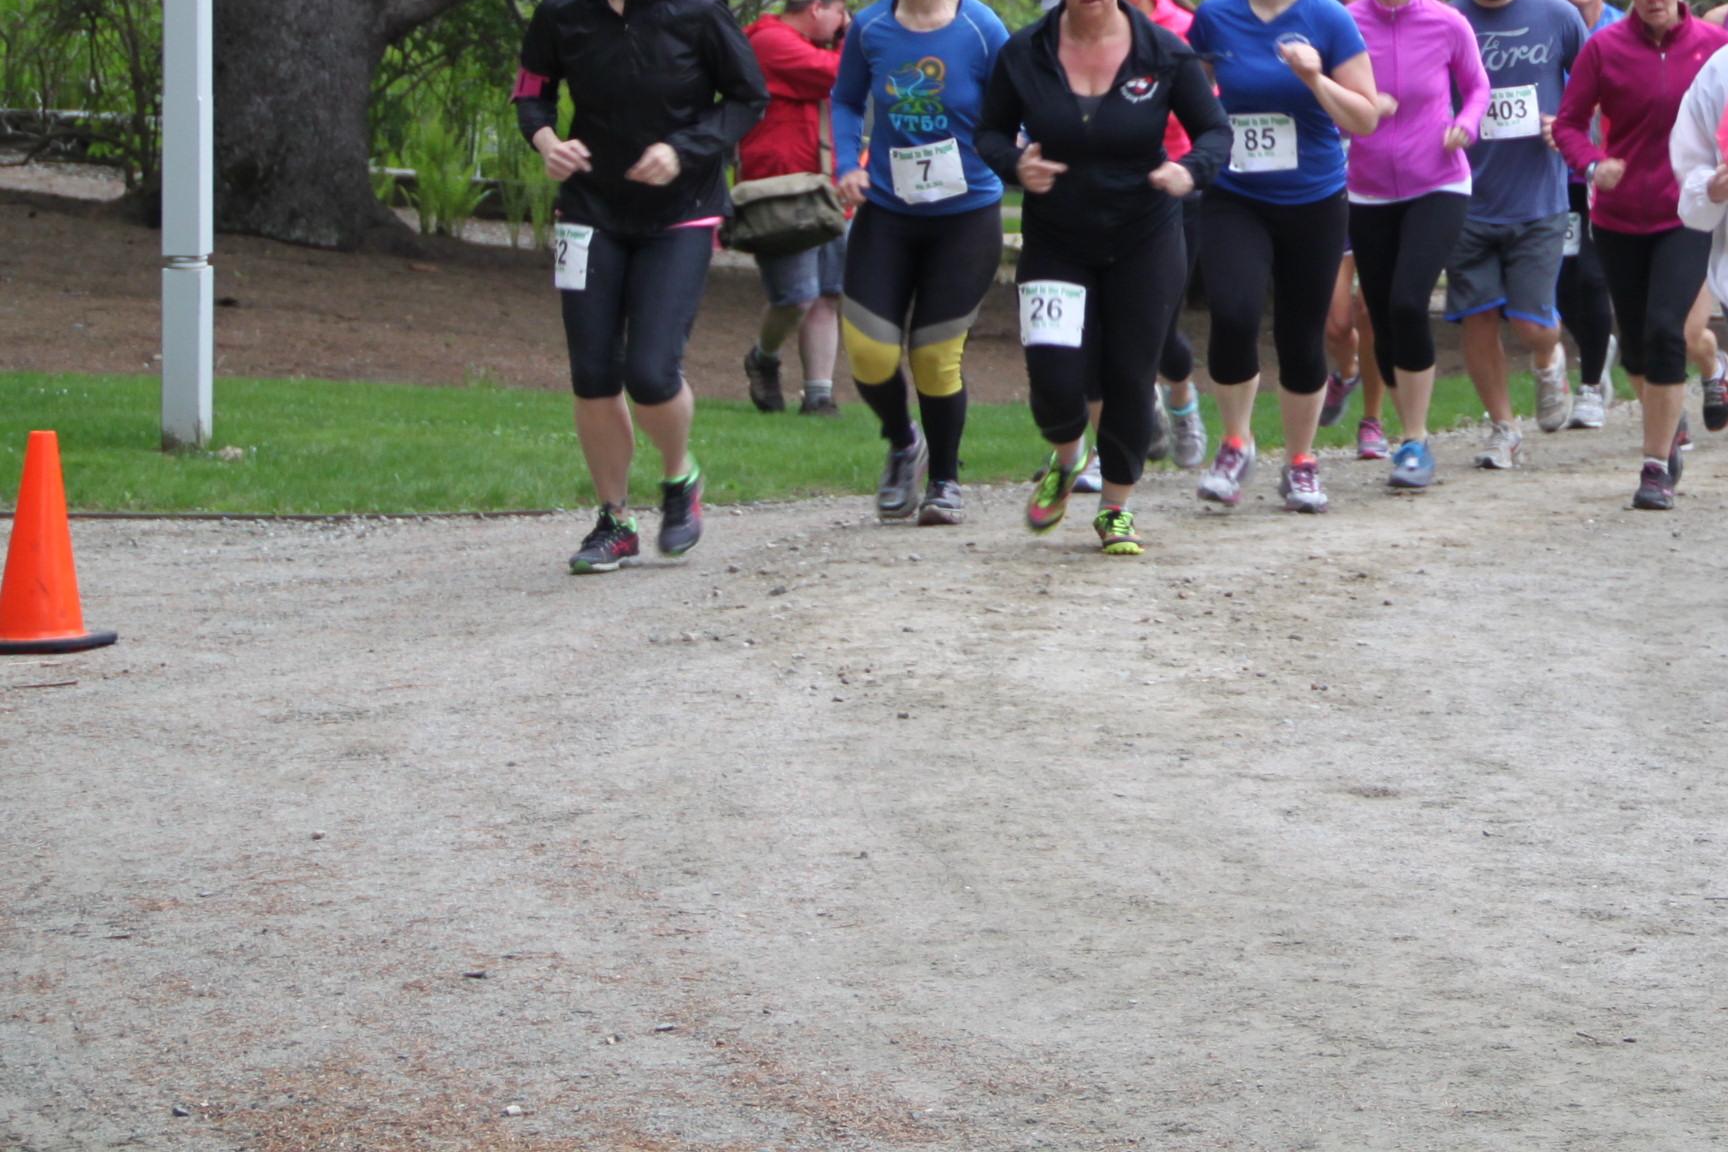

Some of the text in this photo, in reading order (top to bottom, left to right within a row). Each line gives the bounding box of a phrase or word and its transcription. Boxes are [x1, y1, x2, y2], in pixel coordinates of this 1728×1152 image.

[1476, 27, 1553, 70] Ford
[888, 112, 948, 132] VT50
[1487, 99, 1527, 121] 403
[1245, 128, 1276, 152] 85
[916, 159, 931, 183] 7
[1030, 296, 1063, 321] 26
